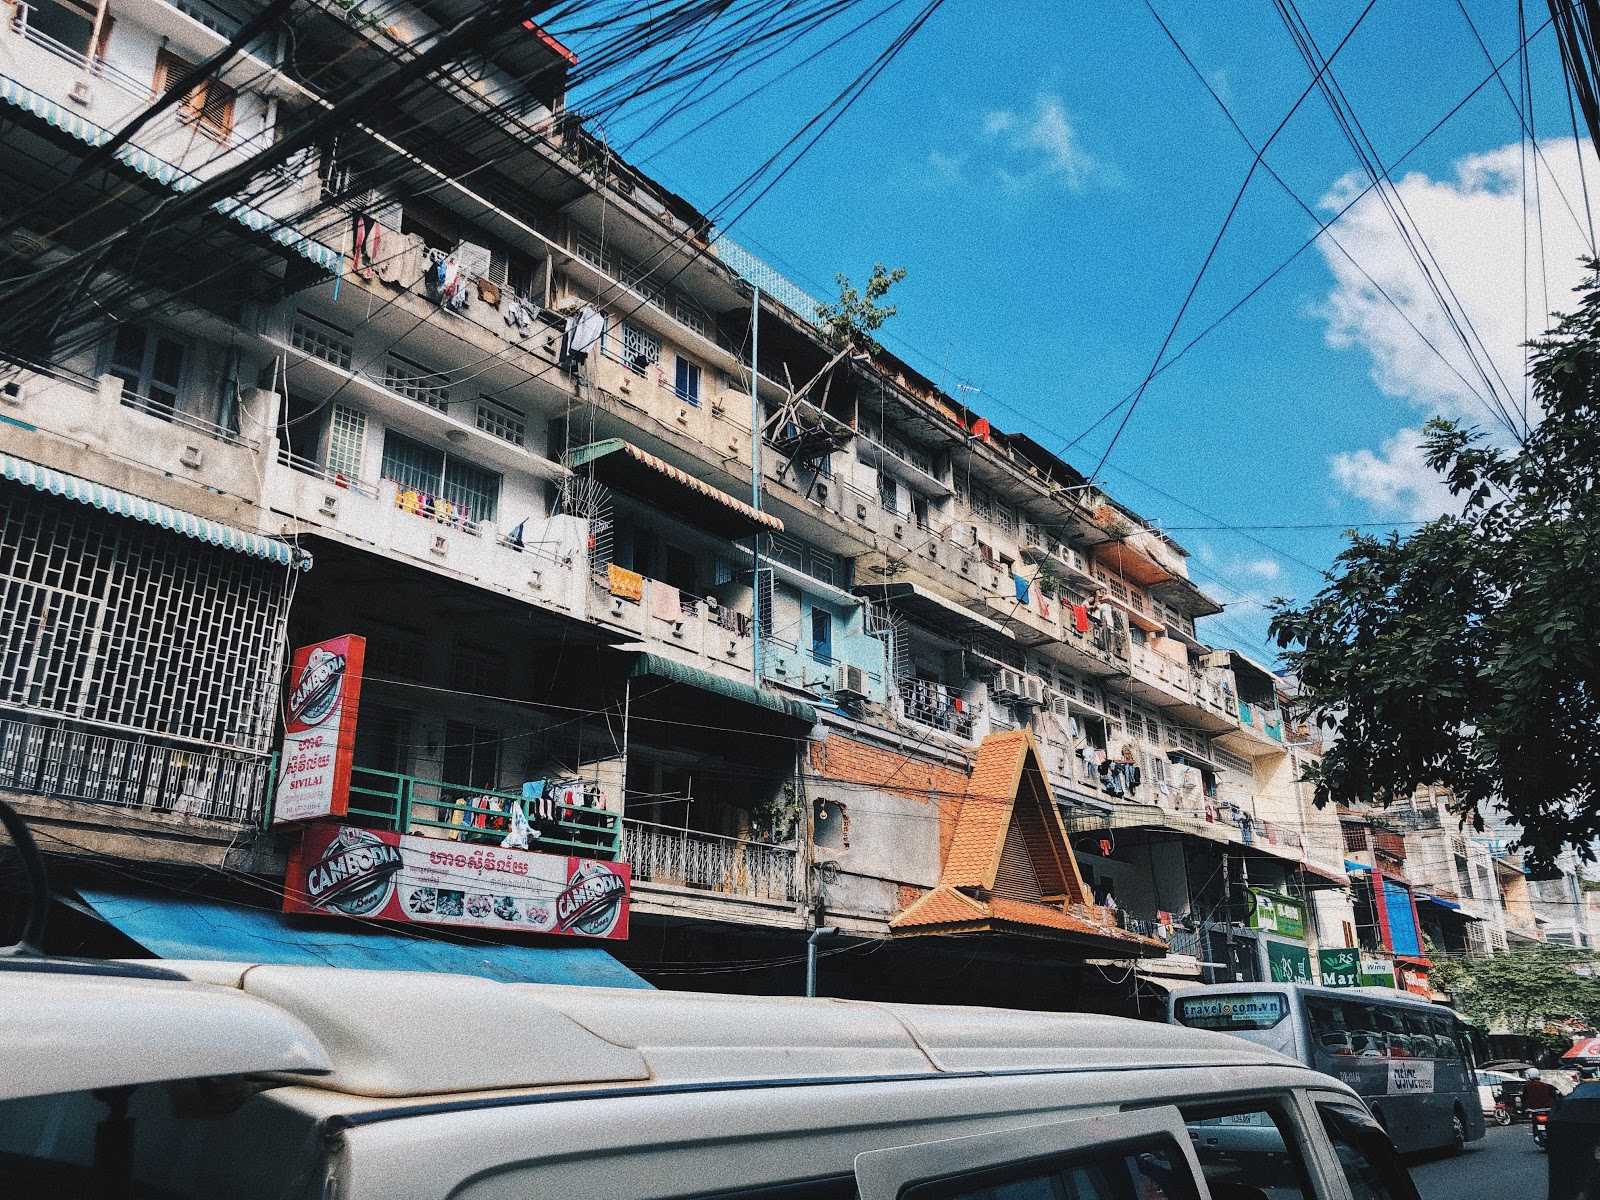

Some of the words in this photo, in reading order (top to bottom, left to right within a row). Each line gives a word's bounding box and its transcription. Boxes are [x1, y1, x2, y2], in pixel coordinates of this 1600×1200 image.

[290, 656, 346, 712] CAMBODIA
[289, 775, 323, 790] SIVILAI
[308, 846, 400, 895] CAMBODIA
[350, 894, 378, 911] Beer
[558, 875, 624, 919] CAMBODIA
[588, 917, 609, 933] Beer
[1281, 956, 1294, 981] RS
[1337, 952, 1354, 964] RS
